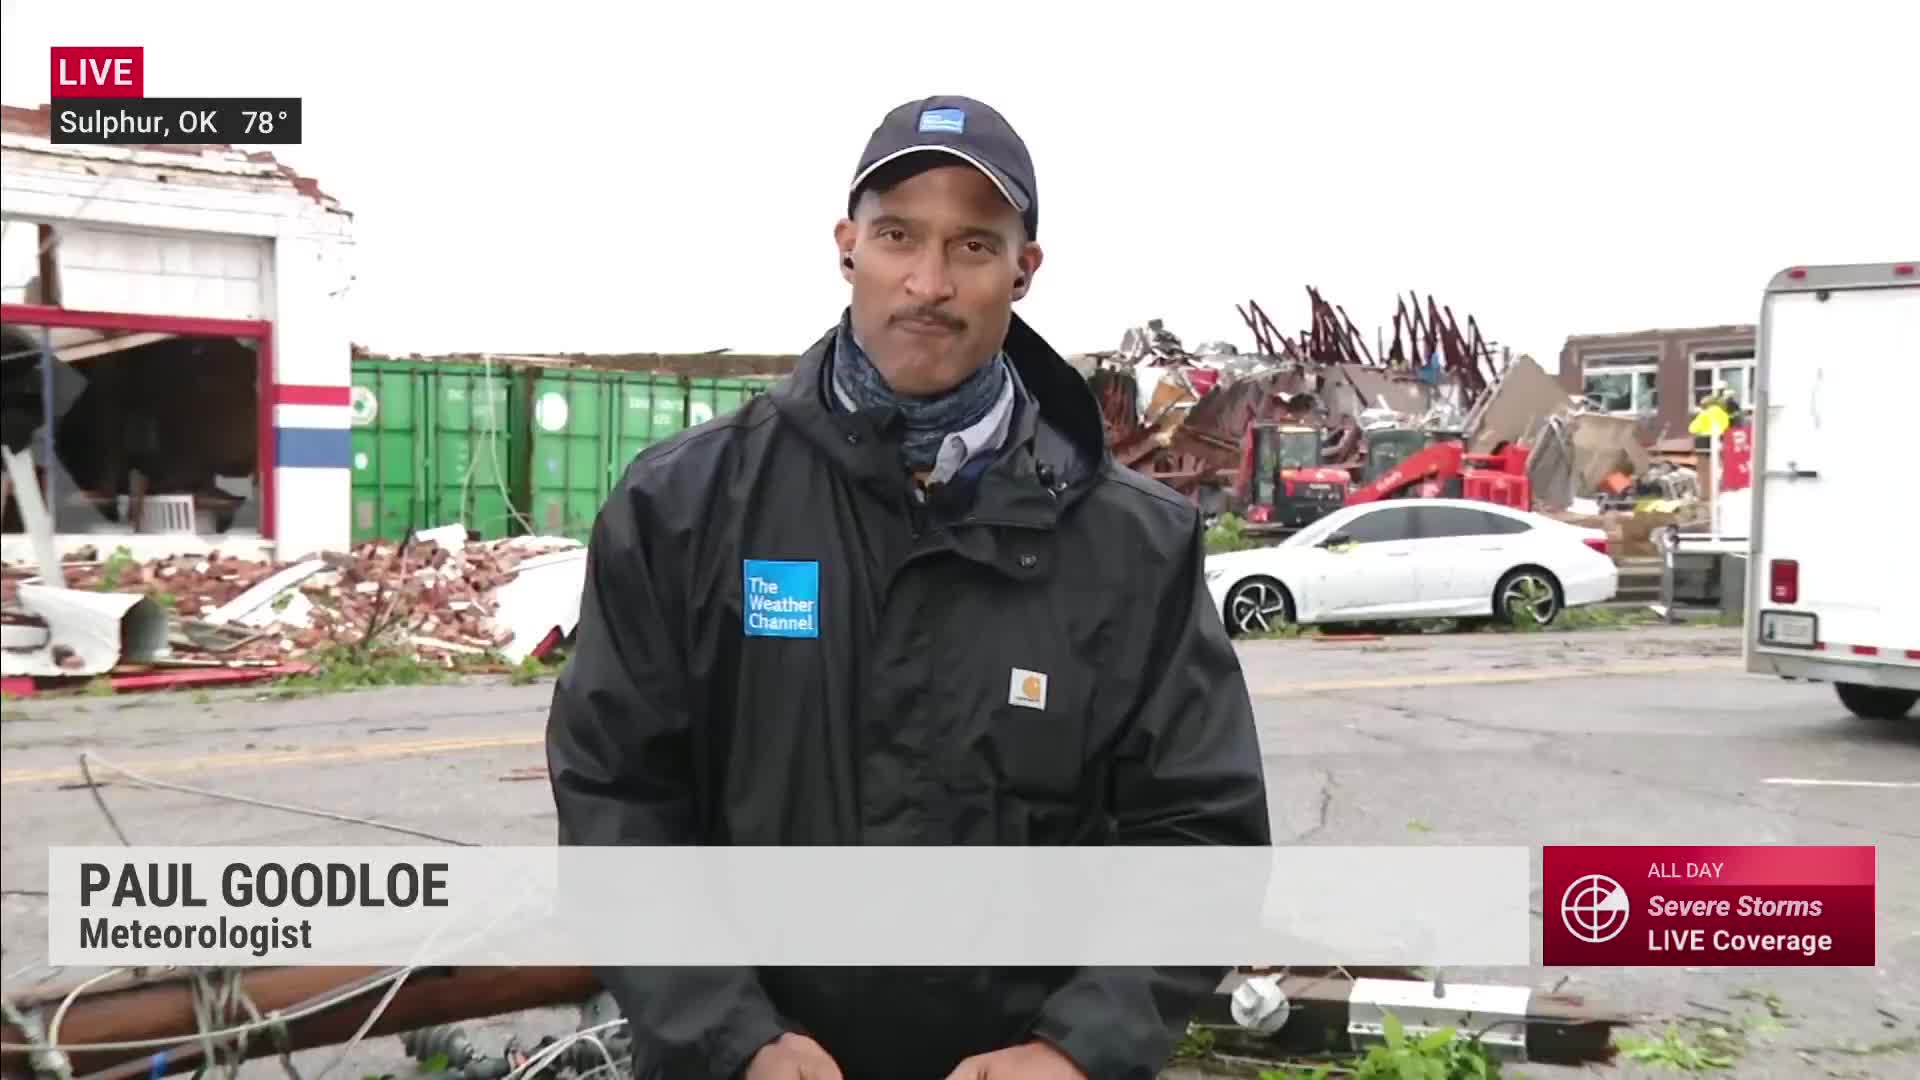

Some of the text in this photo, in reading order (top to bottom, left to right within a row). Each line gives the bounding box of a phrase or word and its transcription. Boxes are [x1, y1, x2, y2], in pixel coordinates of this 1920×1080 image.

[748, 576, 779, 594] The
[748, 594, 815, 613] Weather
[748, 612, 815, 631] Channel
